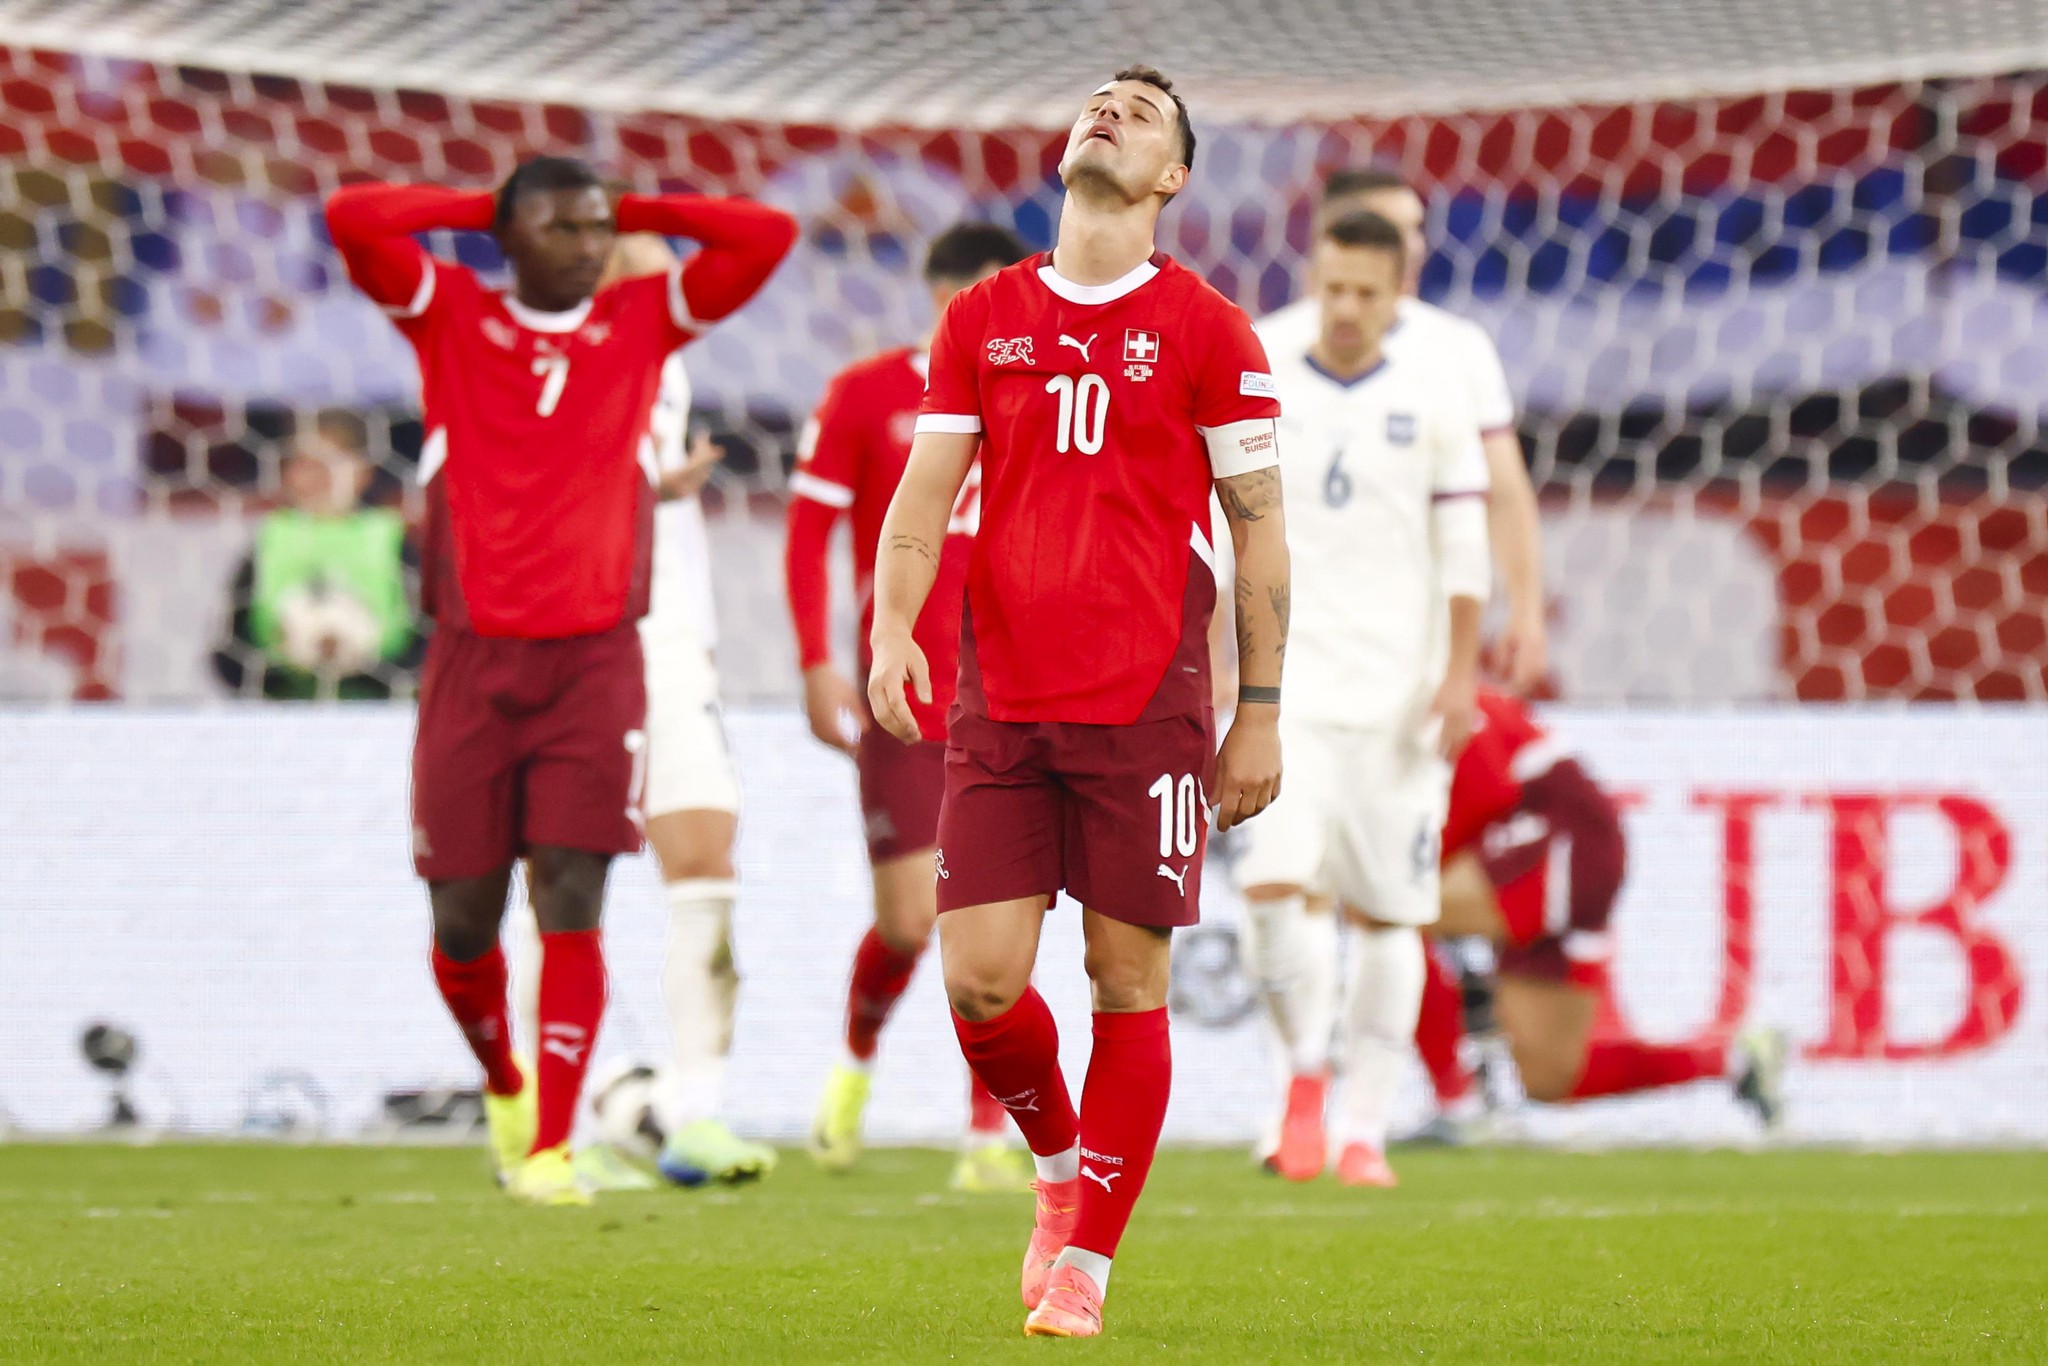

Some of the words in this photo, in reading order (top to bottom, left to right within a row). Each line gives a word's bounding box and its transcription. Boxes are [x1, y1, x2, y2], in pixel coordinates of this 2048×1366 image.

[530, 355, 570, 417] 7
[1045, 373, 1110, 455] 10
[1323, 448, 1351, 510] 6
[1148, 772, 1197, 858] 10
